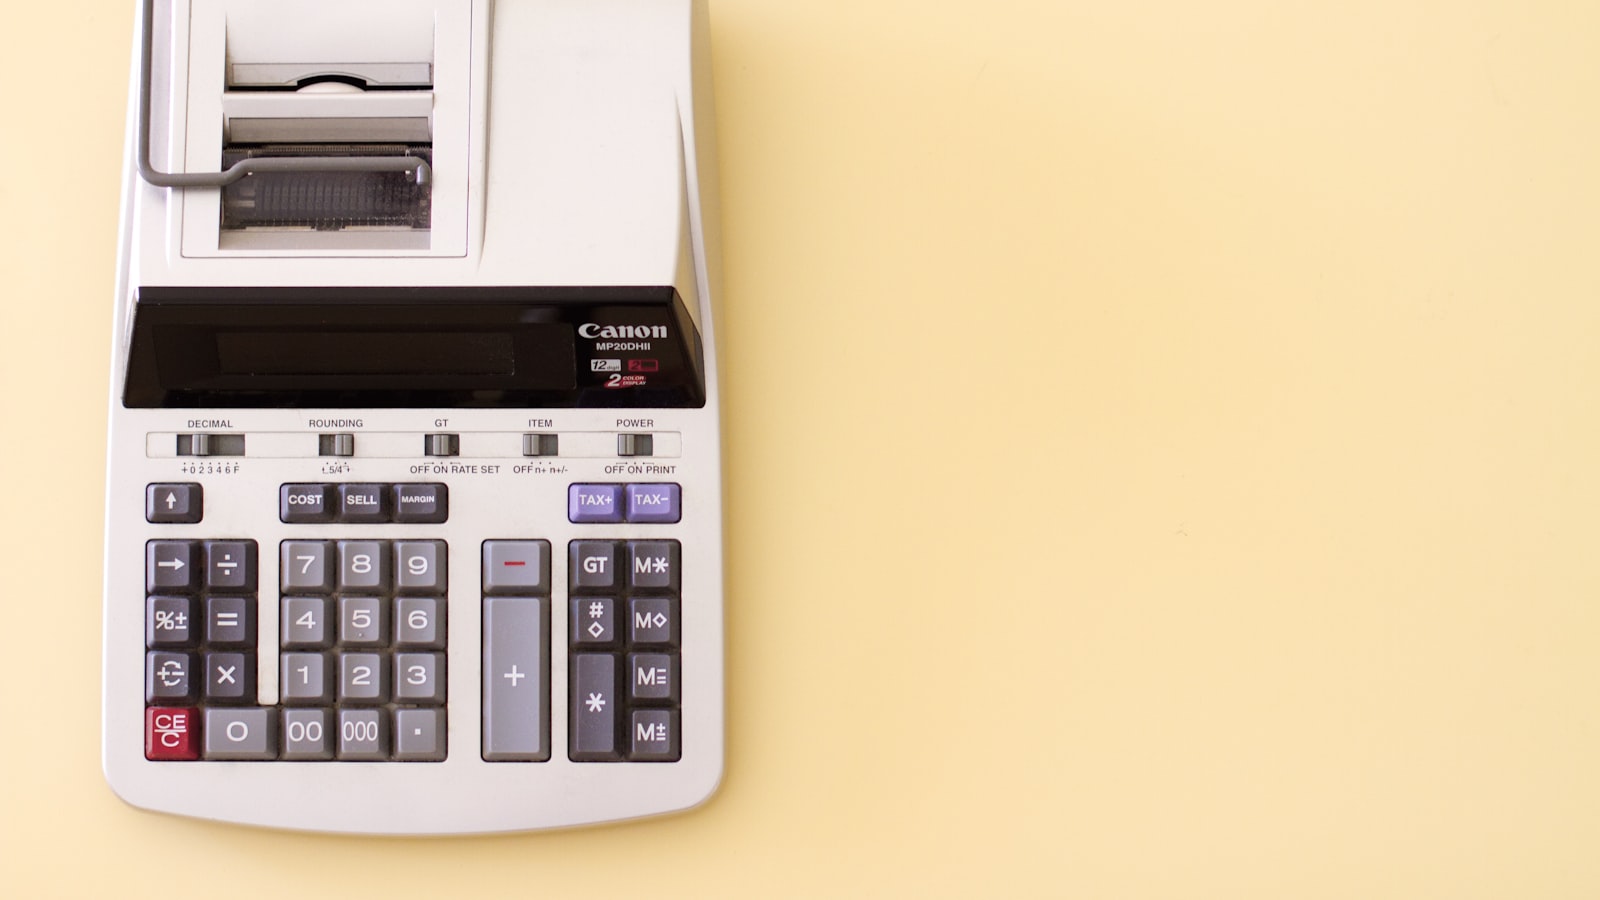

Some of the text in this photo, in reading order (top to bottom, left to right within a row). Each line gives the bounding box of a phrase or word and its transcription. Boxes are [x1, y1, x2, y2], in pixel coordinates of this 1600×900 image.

[578, 323, 667, 338] Canon
[596, 342, 650, 350] MP20DHII
[592, 360, 607, 370] 12
[608, 373, 622, 386] 2
[188, 420, 234, 428] DECIMAL
[309, 419, 363, 428] ROUNDING
[434, 419, 448, 428] GT
[528, 419, 552, 428] ITEM
[616, 419, 654, 428] POWER
[288, 494, 322, 505] COST
[346, 494, 377, 505] SELL
[401, 495, 435, 503] MARGIN
[579, 494, 612, 505] TAX+
[296, 556, 315, 574] 7
[351, 554, 371, 573] 8
[408, 556, 428, 574] 9
[583, 557, 608, 573] GT
[296, 611, 316, 629] 4
[351, 610, 371, 628] 5
[408, 610, 428, 629] 6
[297, 666, 308, 684] 1
[352, 666, 371, 685] 2
[407, 666, 427, 685] 3
[155, 715, 186, 728] CE
[161, 732, 180, 748] C
